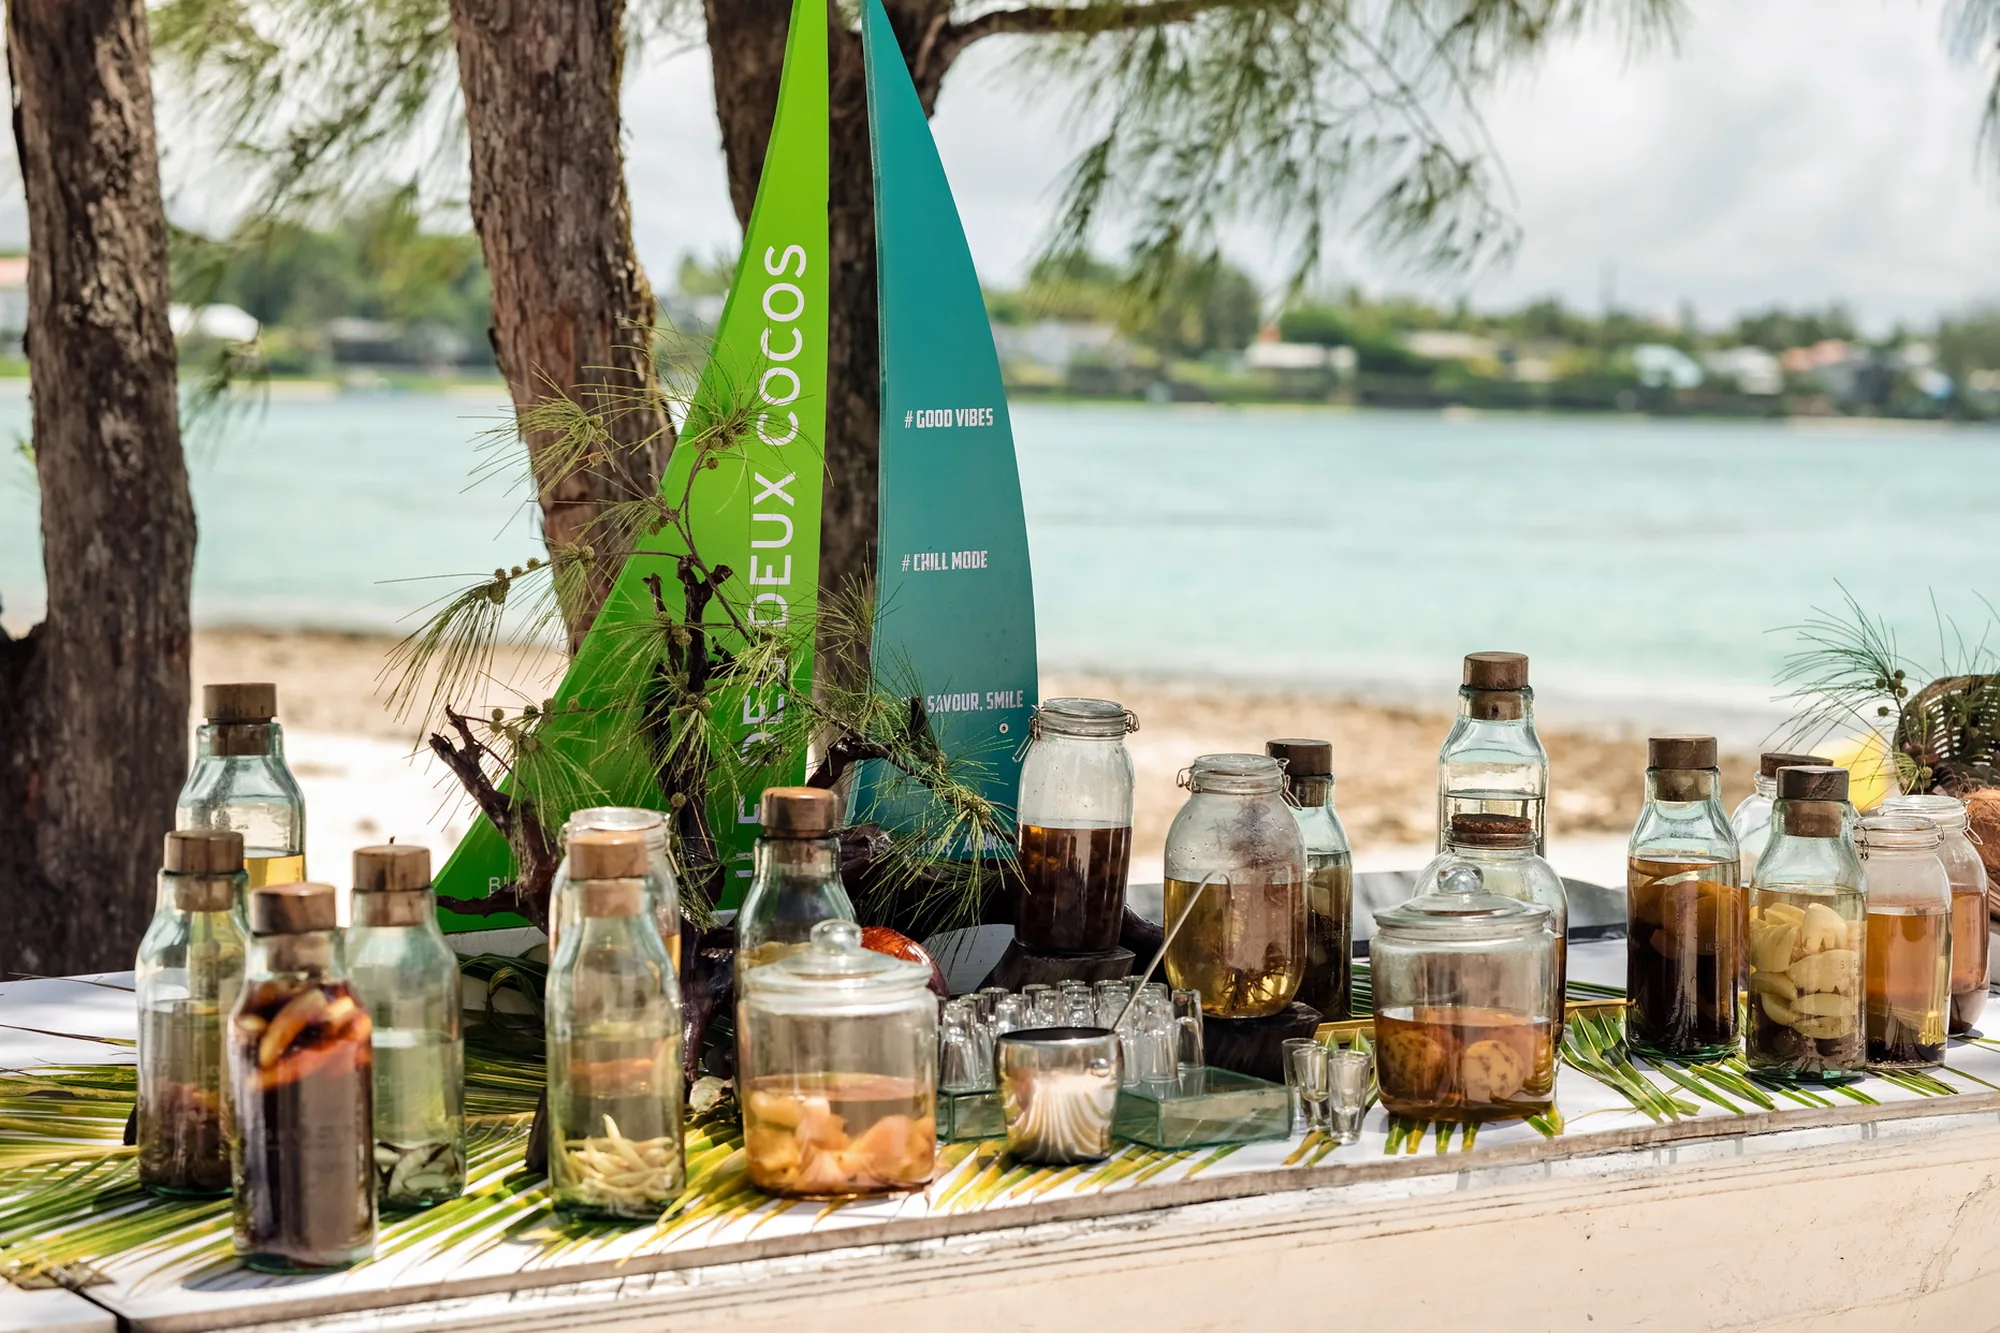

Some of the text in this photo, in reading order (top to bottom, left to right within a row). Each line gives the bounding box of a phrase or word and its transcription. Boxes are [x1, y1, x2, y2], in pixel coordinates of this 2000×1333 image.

[756, 244, 807, 446] COCOS
[955, 408, 994, 428] VIBES
[748, 471, 797, 628] DEUX
[951, 550, 988, 570] MODE
[927, 692, 983, 713] SAVOUR,
[986, 689, 1024, 710] SMILE
